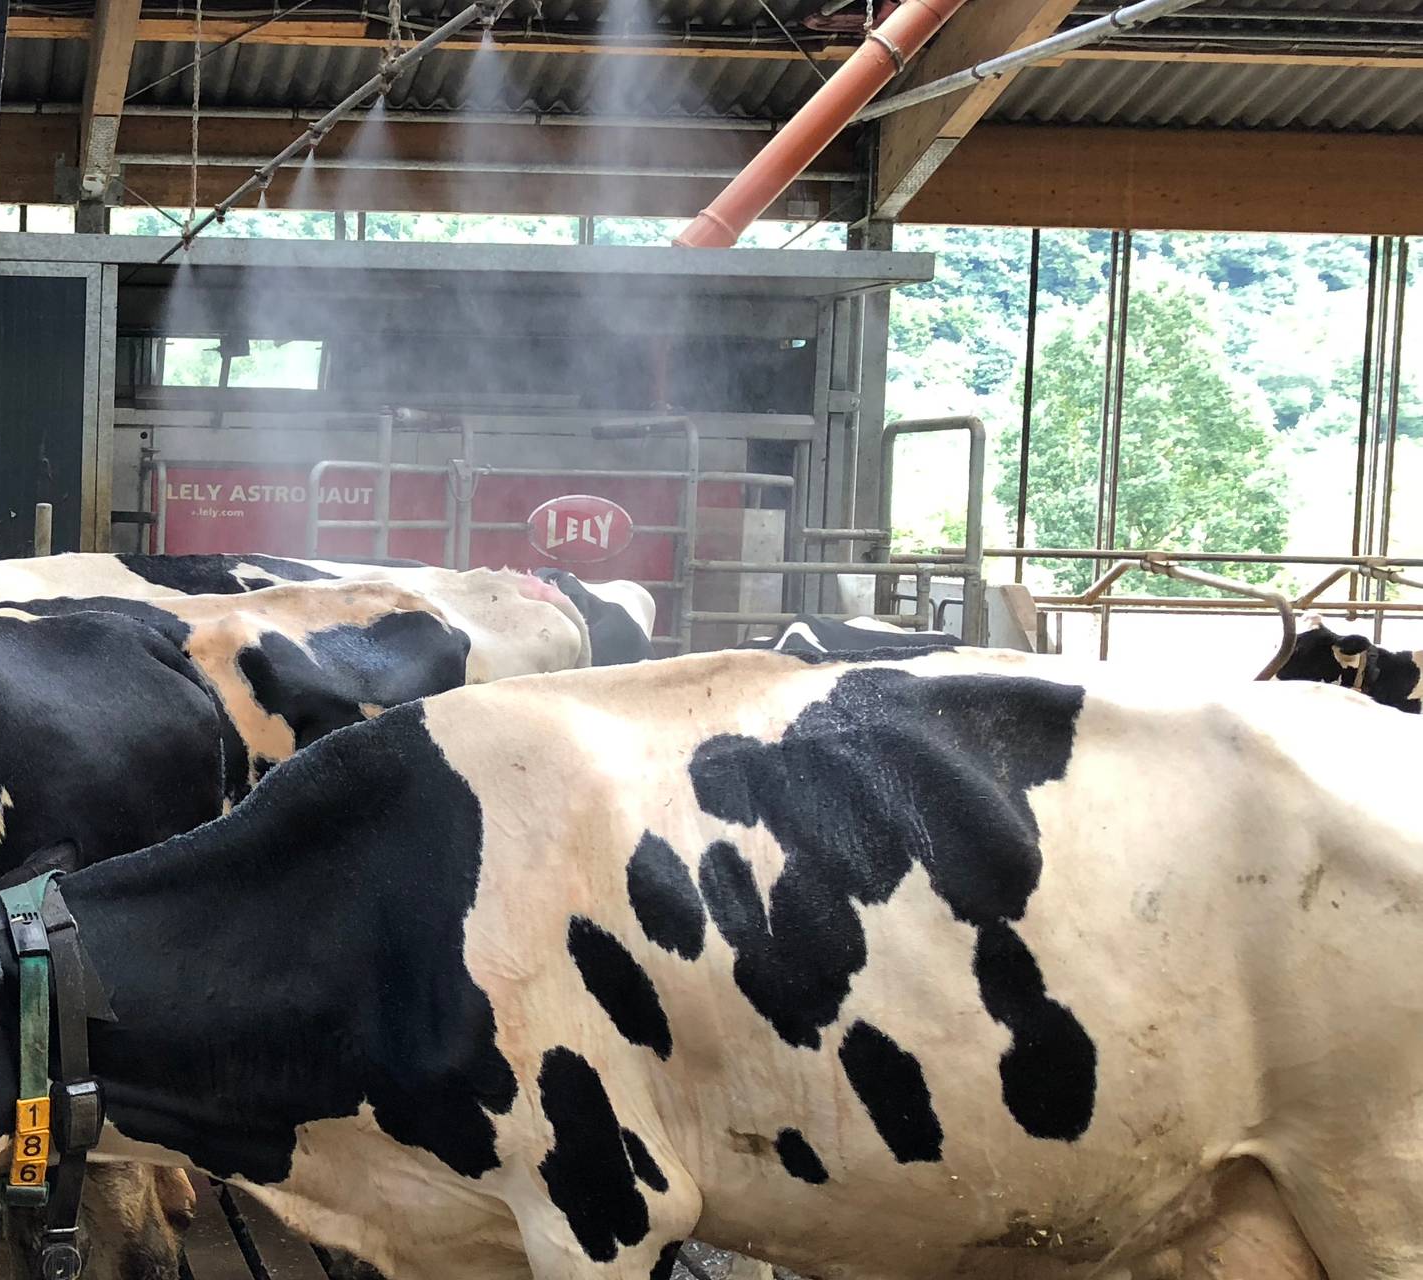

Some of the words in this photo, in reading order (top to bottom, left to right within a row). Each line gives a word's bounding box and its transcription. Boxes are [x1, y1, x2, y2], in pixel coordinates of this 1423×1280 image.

[167, 483, 223, 501] LELY
[546, 509, 613, 549] LELY
[20, 1104, 41, 1182] 186
